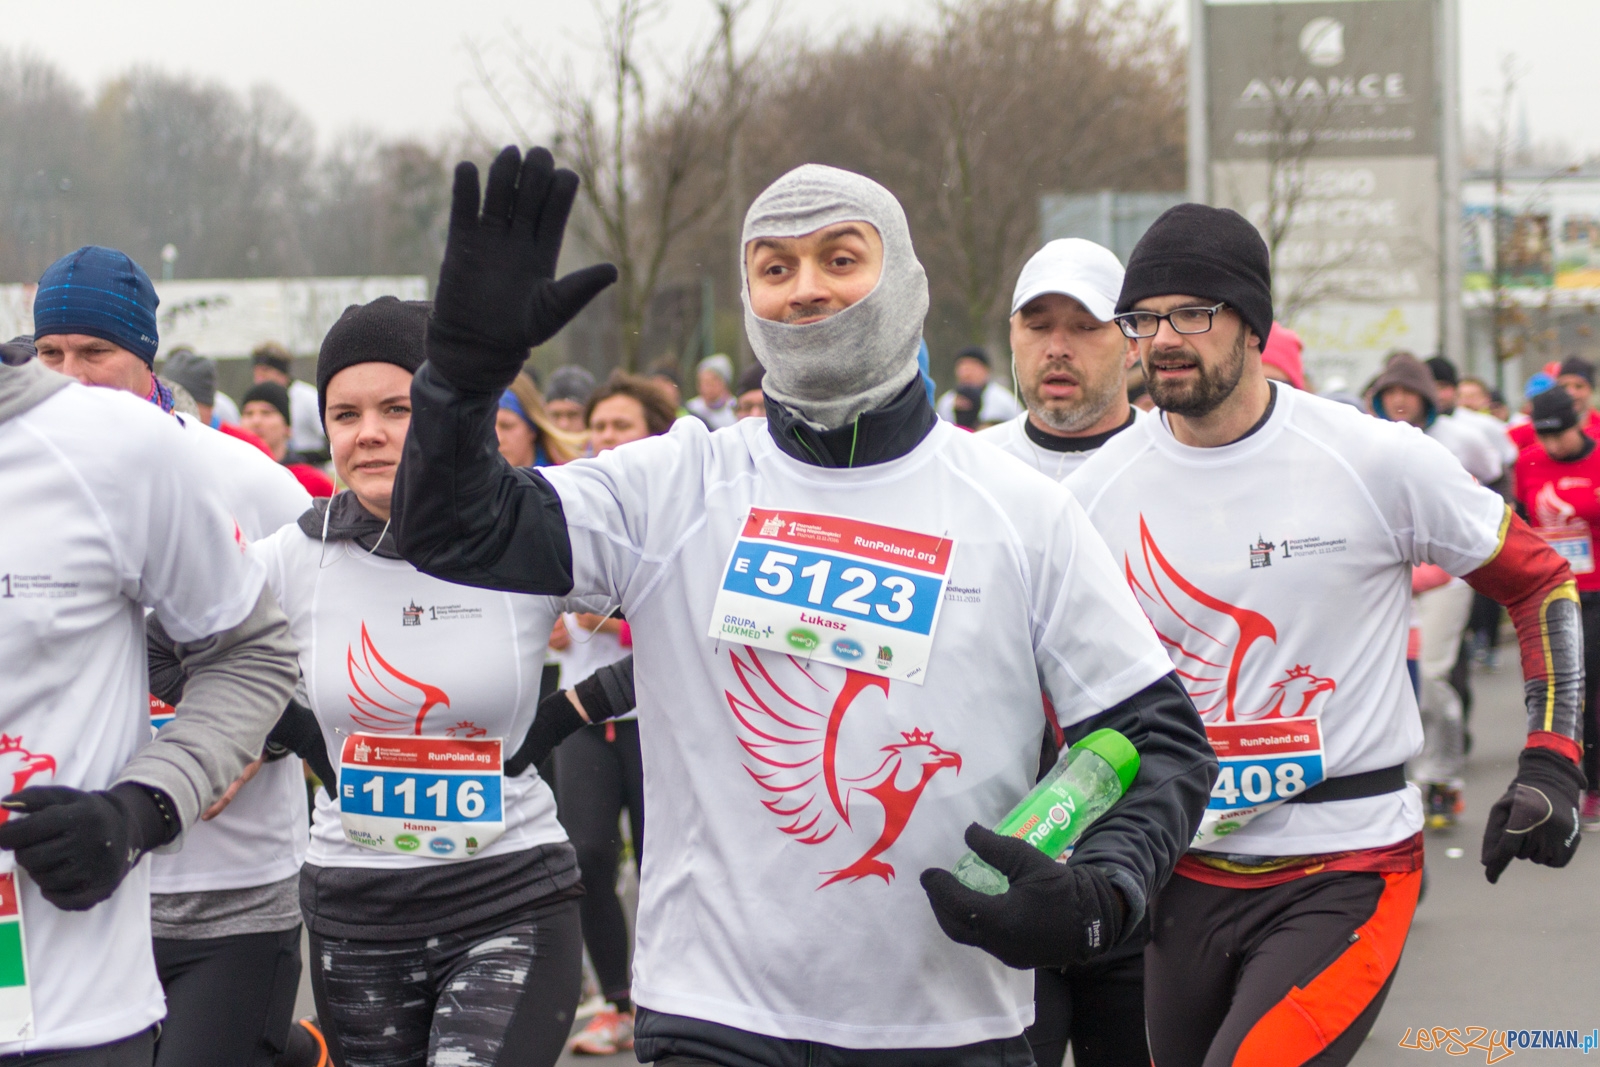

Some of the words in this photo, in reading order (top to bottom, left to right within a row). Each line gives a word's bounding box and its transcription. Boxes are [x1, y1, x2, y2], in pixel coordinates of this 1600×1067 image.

[1241, 73, 1406, 101] AVANCE
[854, 535, 937, 565] RunPoland.org
[1280, 539, 1292, 559] 1
[734, 557, 751, 574] E
[754, 550, 917, 623] 5123
[723, 614, 756, 630] GRUPA
[799, 612, 847, 632] Łukasz
[721, 623, 761, 641] LUXMED
[1240, 734, 1310, 747] RunPoland.org
[428, 752, 491, 763] RunPoland.org
[343, 784, 355, 798] E
[362, 775, 486, 819] 1116
[403, 821, 437, 832] Hanna
[1025, 795, 1076, 846] nergy
